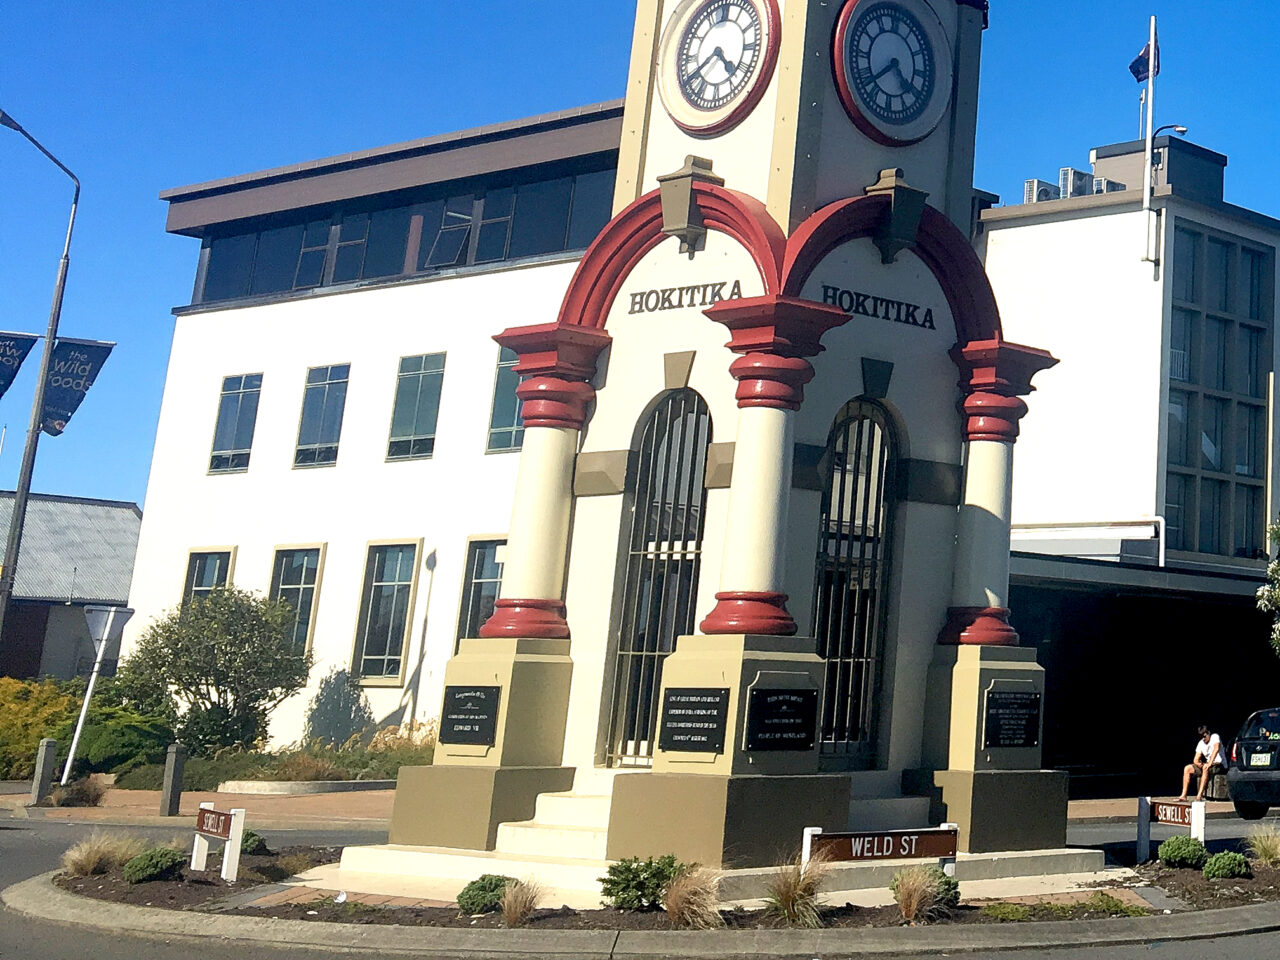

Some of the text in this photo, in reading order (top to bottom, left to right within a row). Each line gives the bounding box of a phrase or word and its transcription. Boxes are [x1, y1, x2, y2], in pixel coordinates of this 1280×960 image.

[628, 280, 742, 314] HOKITIKA
[822, 285, 936, 330] HOKITIKA
[68, 351, 88, 361] the
[54, 359, 92, 376] Wild
[1158, 805, 1183, 822] SEWELL
[851, 836, 918, 857] WELD ST
